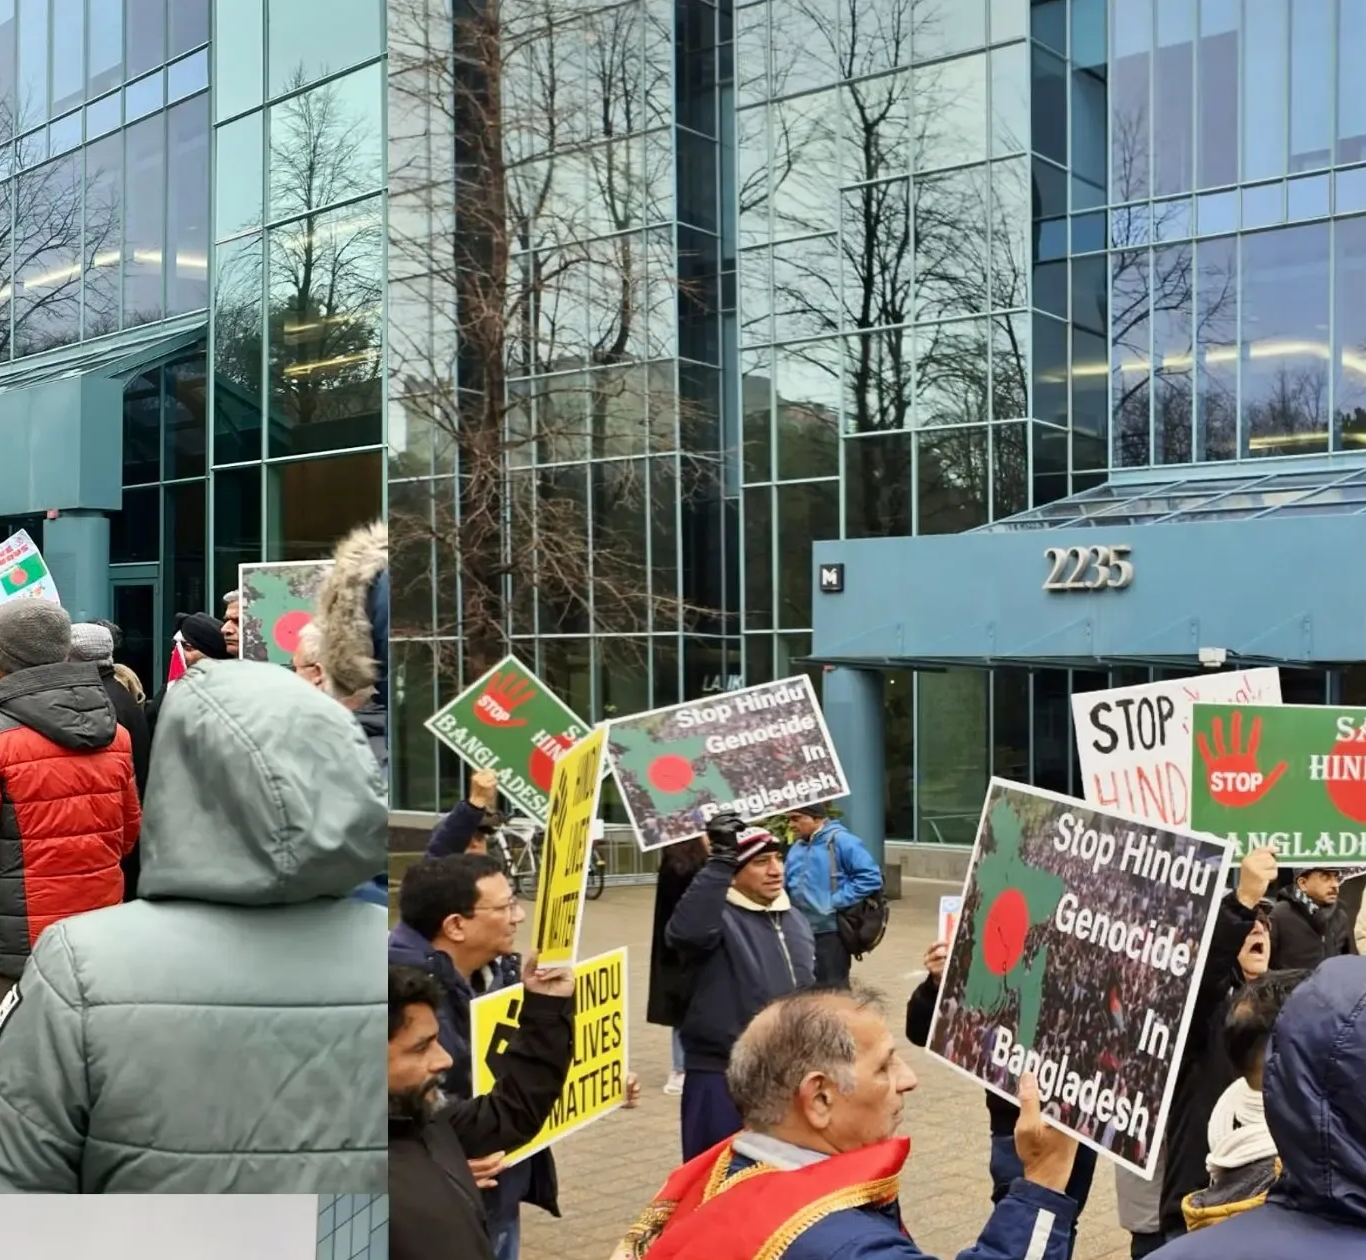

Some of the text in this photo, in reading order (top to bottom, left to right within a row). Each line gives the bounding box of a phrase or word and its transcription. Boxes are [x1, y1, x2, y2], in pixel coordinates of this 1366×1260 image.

[1042, 545, 1133, 592] 2235
[477, 695, 510, 721] STOP
[675, 683, 806, 728] Stop Hindu
[1089, 695, 1175, 754] STOP
[705, 715, 815, 754] Genocide
[801, 745, 826, 762] In
[1094, 761, 1189, 826] HIND
[1210, 772, 1263, 792] STOP
[1053, 812, 1211, 897] Stop Hindu
[1054, 893, 1191, 977] Genocide
[1137, 1009, 1170, 1060] In
[548, 1060, 622, 1130] MATTER
[991, 1025, 1149, 1140] Bangladesh
